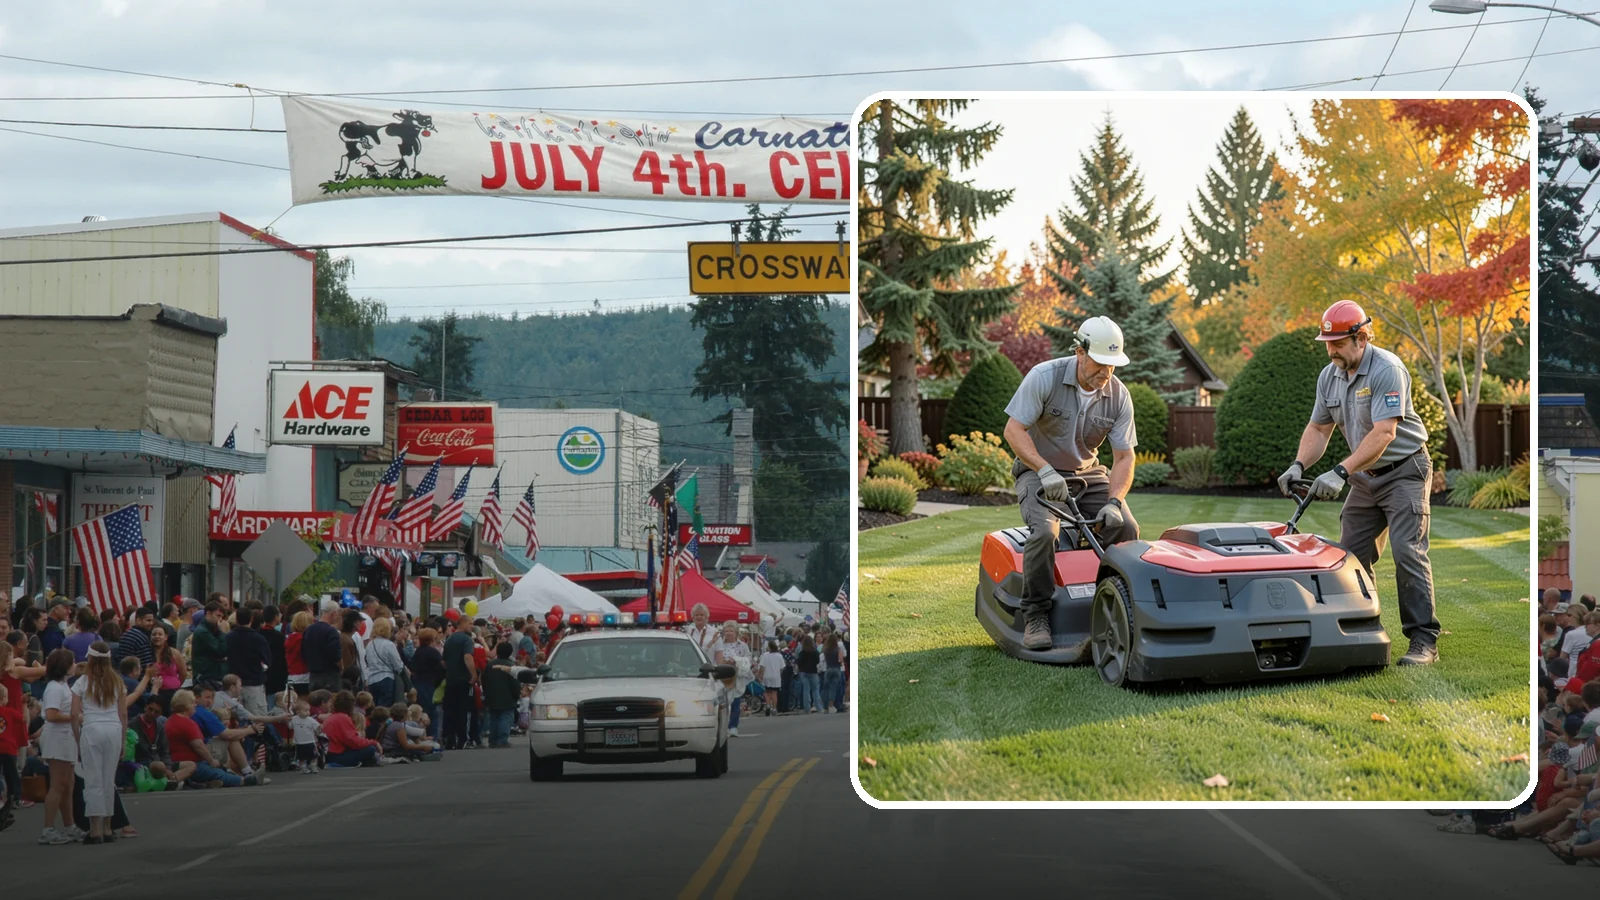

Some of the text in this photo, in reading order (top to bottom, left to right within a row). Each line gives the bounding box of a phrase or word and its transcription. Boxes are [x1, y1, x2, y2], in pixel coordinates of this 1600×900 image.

[481, 141, 605, 193] JULY
[632, 150, 747, 198] 4th.
[697, 254, 850, 280] CROSSWA
[283, 380, 373, 419] ACE
[406, 410, 485, 421] CEDAR LOG
[284, 421, 371, 436] Hardware
[96, 485, 124, 495] Vincent
[126, 486, 136, 495] de
[137, 487, 155, 495] Paul
